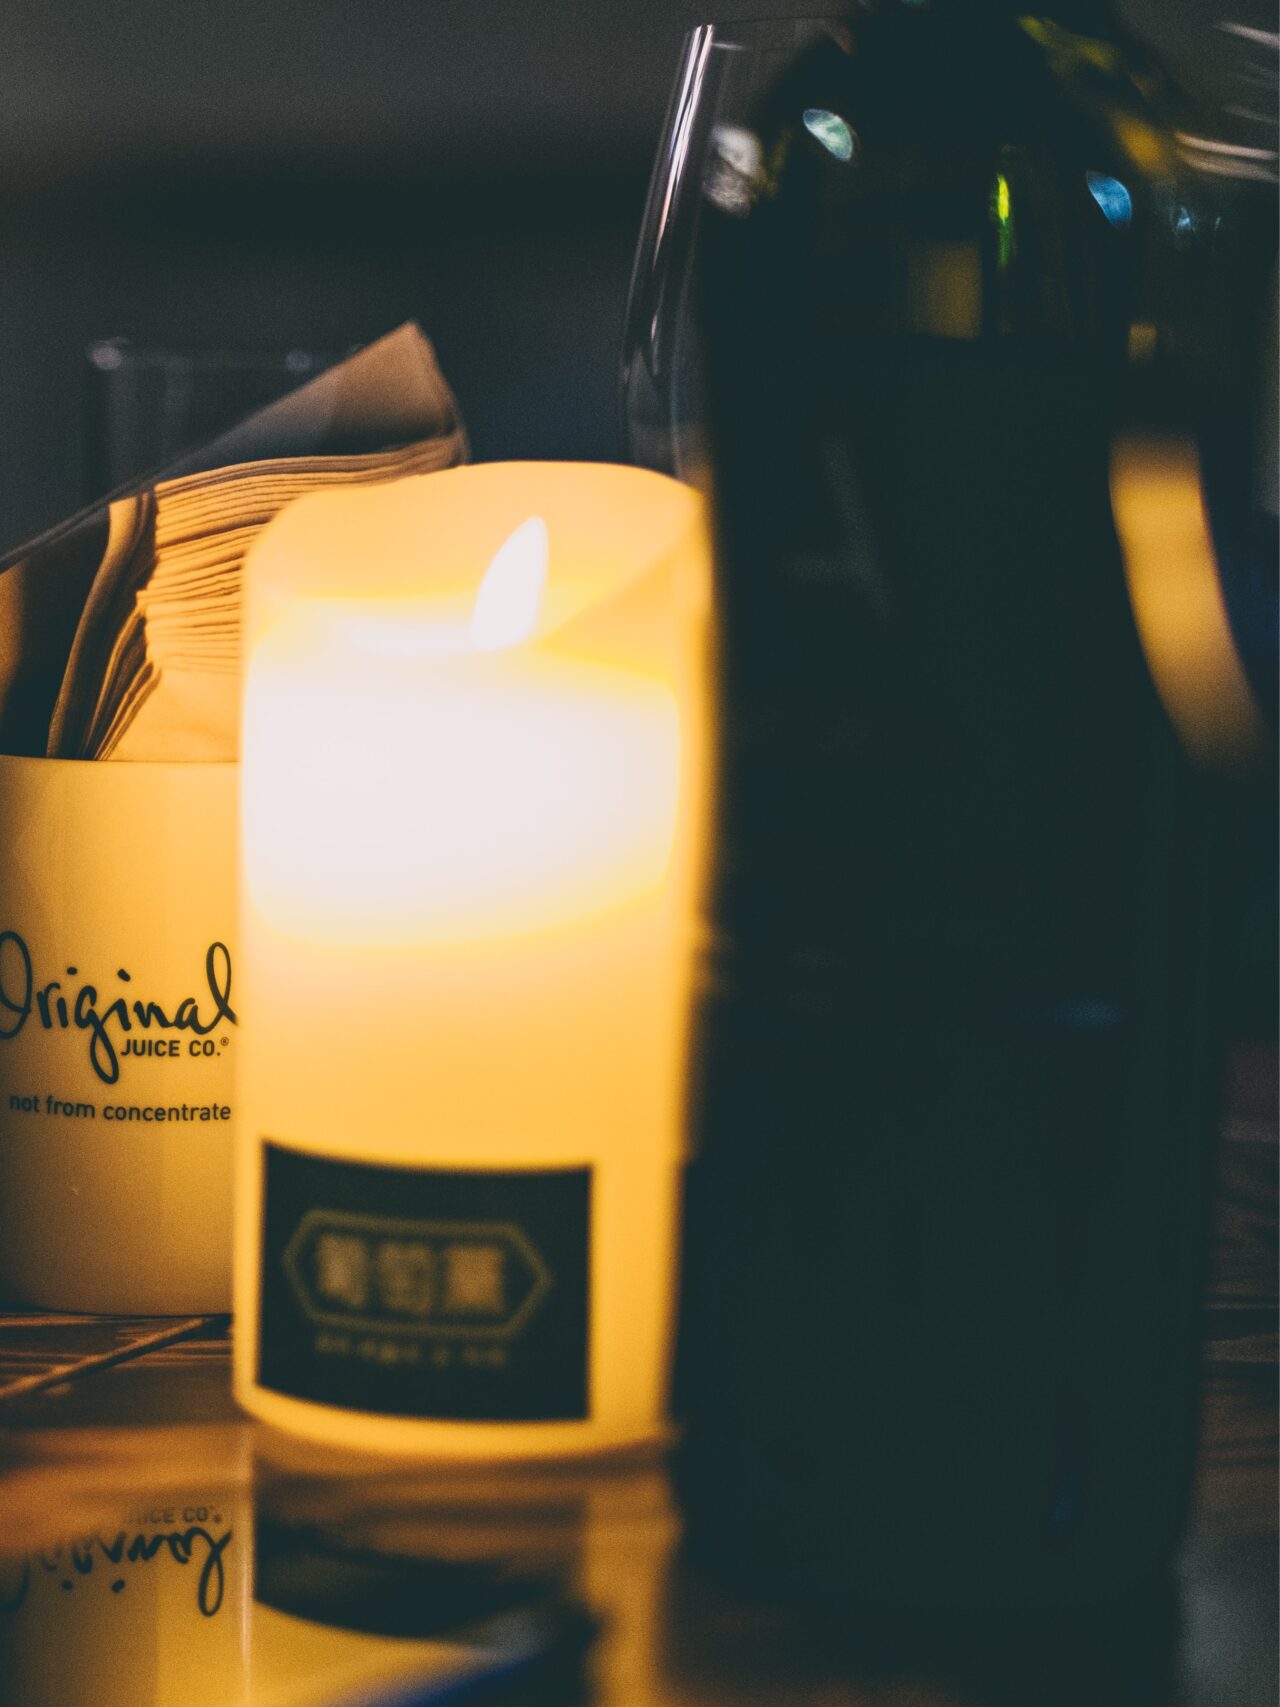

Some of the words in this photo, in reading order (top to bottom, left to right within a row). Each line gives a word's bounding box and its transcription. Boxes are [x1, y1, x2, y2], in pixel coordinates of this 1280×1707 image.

[120, 1039, 180, 1057] JUICE
[9, 1094, 40, 1113] not
[46, 1095, 95, 1118] from
[103, 1102, 232, 1122] concentrate
